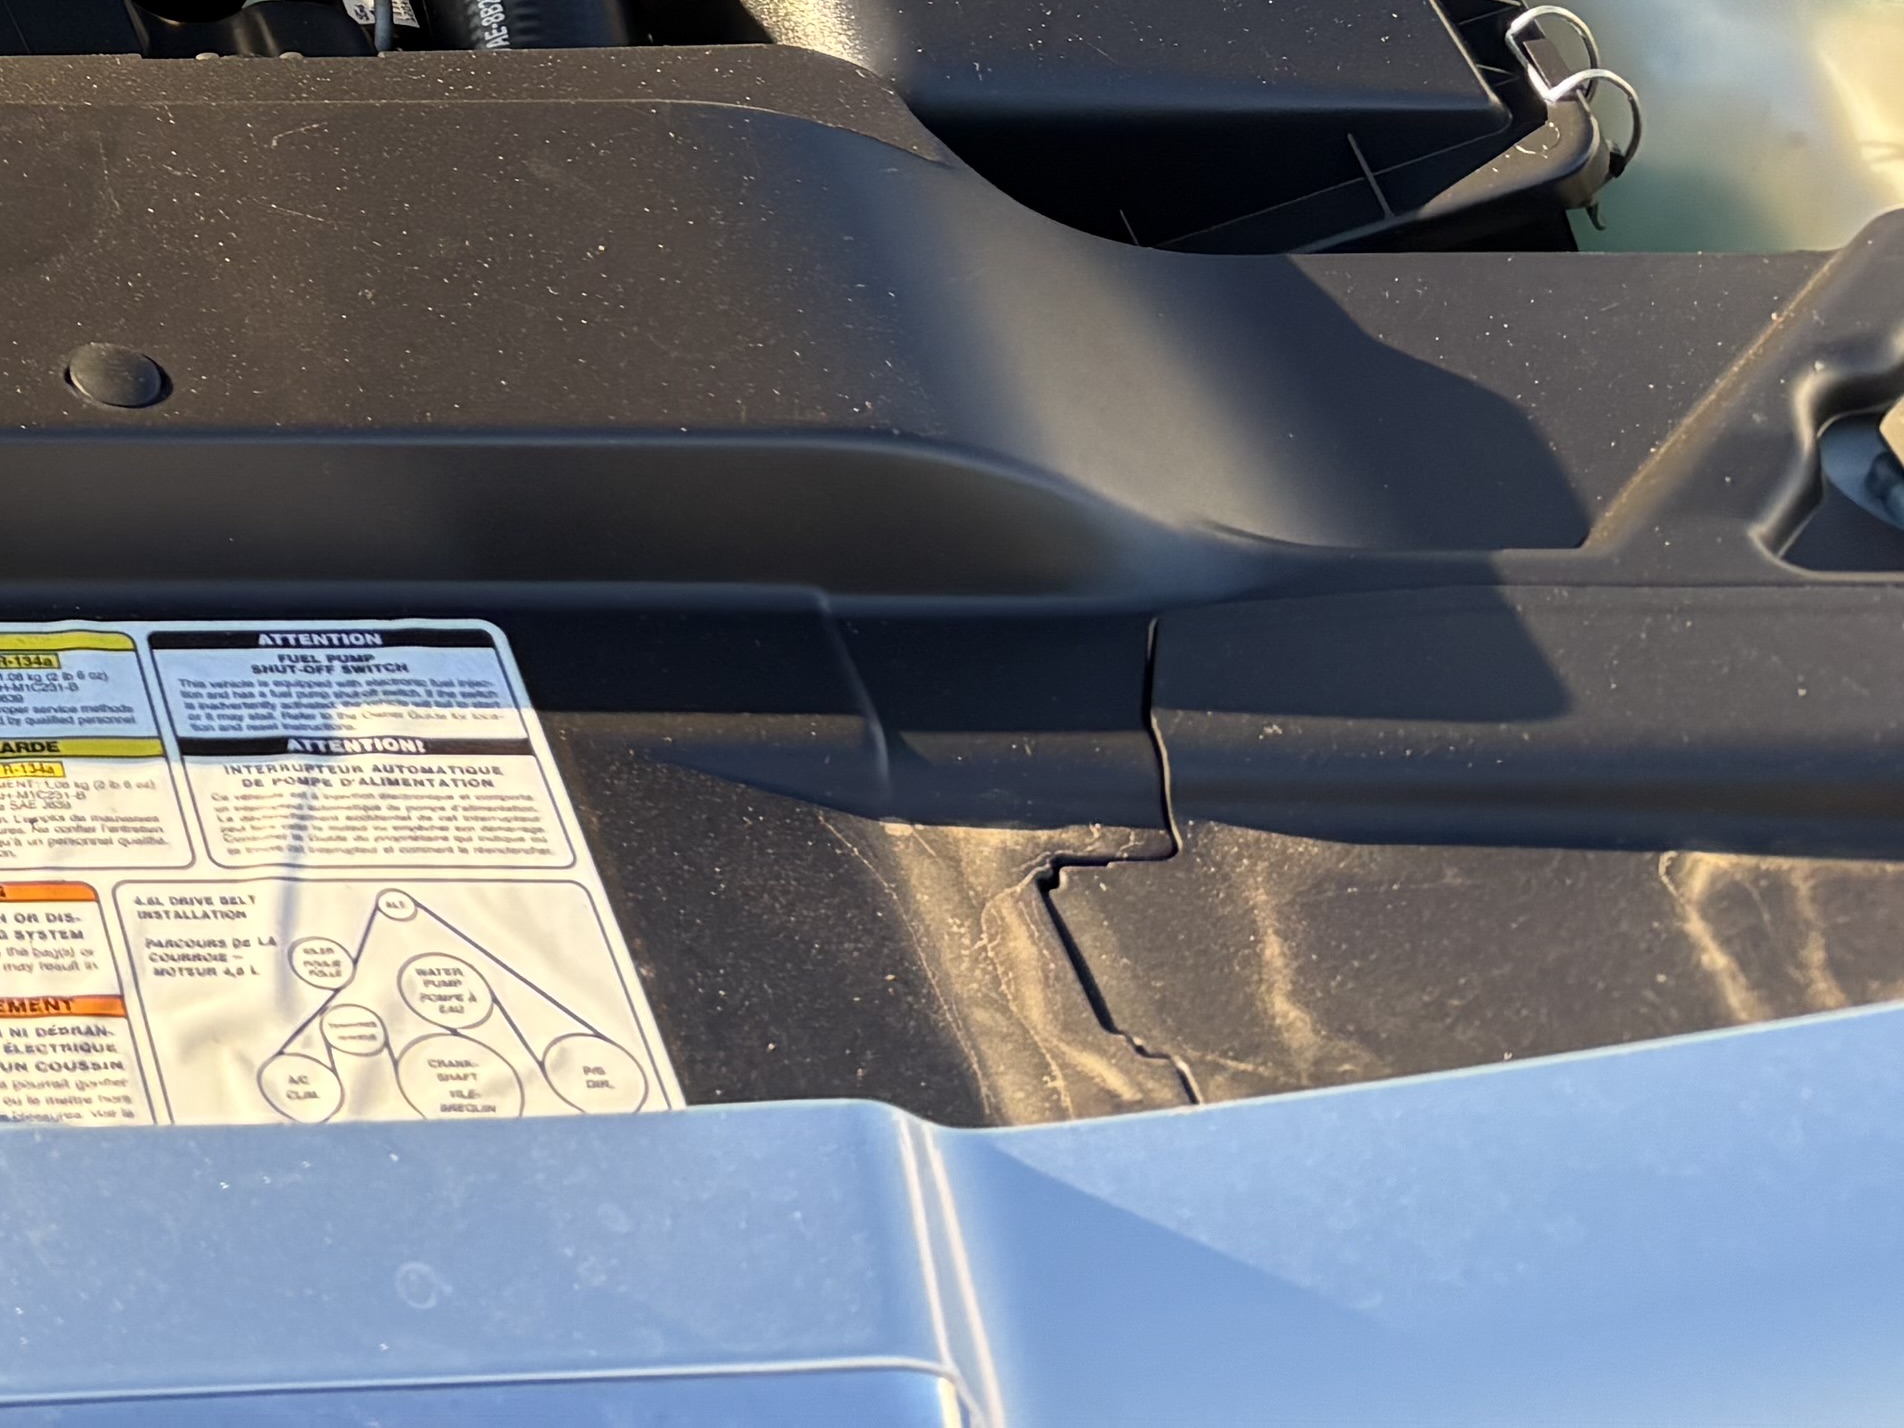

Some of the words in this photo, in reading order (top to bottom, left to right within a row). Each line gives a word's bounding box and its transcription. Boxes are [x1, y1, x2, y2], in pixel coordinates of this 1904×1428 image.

[257, 633, 384, 646] ATTENTION
[277, 654, 320, 665] FUEL
[325, 653, 376, 664] PUMP
[250, 663, 335, 675] SHUT-OFF
[341, 662, 410, 674] SWITCH
[286, 738, 427, 754] ATTENTION!
[371, 763, 504, 776] AUTOMATIQUE
[240, 777, 265, 788] DE
[12, 912, 40, 924] OR
[13, 928, 85, 941] SYSTEM
[34, 1060, 125, 1074] COUSSIN
